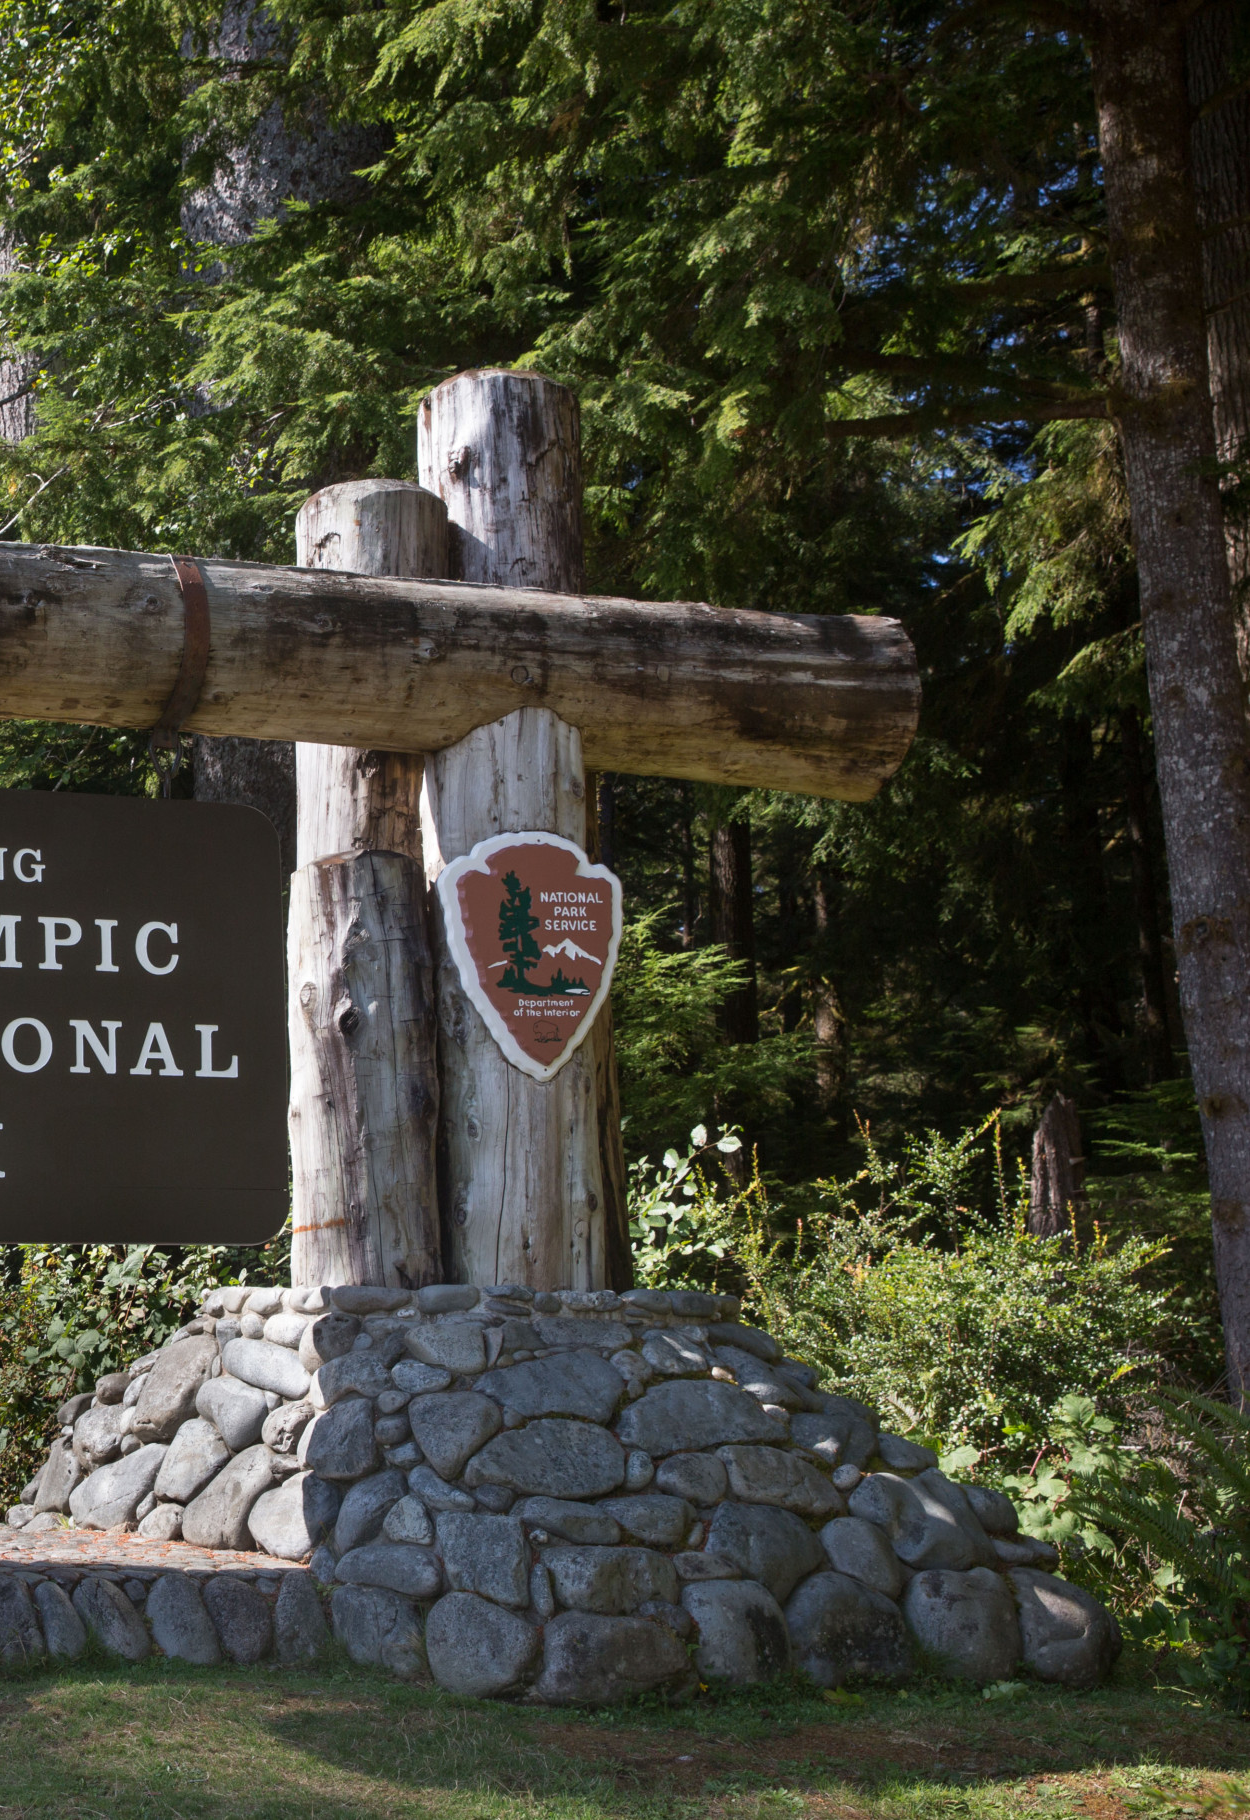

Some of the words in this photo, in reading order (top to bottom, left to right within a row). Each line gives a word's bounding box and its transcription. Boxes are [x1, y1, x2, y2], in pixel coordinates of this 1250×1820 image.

[540, 891, 603, 904] NATIONAL
[554, 906, 588, 917] PARK
[544, 919, 597, 931] SERVICE
[518, 998, 574, 1008] Department
[513, 1008, 524, 1017] of
[526, 1008, 542, 1017] the
[543, 1008, 581, 1017] Interior
